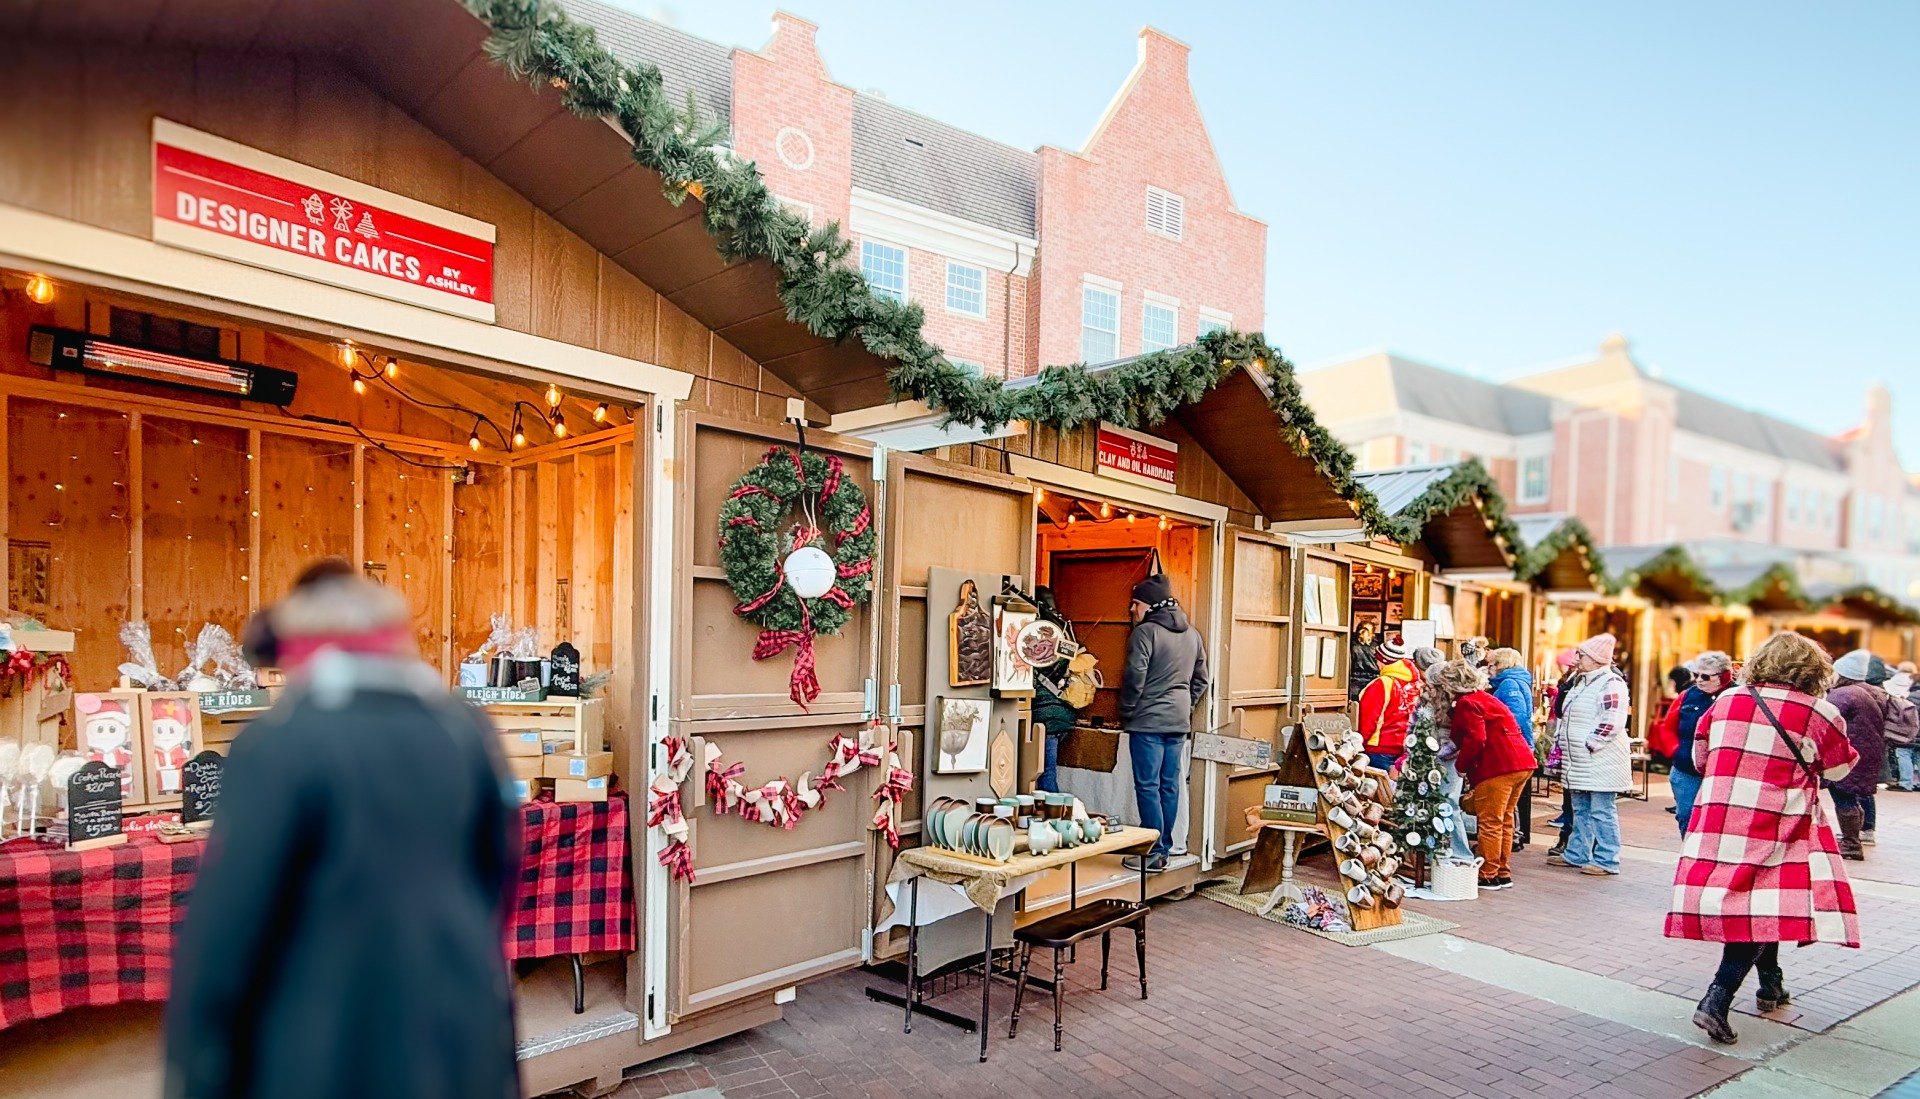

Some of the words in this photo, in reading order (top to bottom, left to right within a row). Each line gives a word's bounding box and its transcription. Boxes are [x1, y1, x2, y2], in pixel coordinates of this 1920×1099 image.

[176, 191, 326, 257] DESIGNER
[336, 236, 421, 281] CAKES
[442, 266, 461, 279] BY
[426, 275, 477, 296] ASHLEY
[1099, 450, 1116, 466] CLAY
[1117, 455, 1130, 469] AND
[1131, 460, 1141, 473] OIL
[1142, 463, 1174, 481] HANDMADE
[218, 692, 252, 706] RIDES
[466, 689, 499, 700] SLEIGH
[501, 688, 526, 700] RIDES
